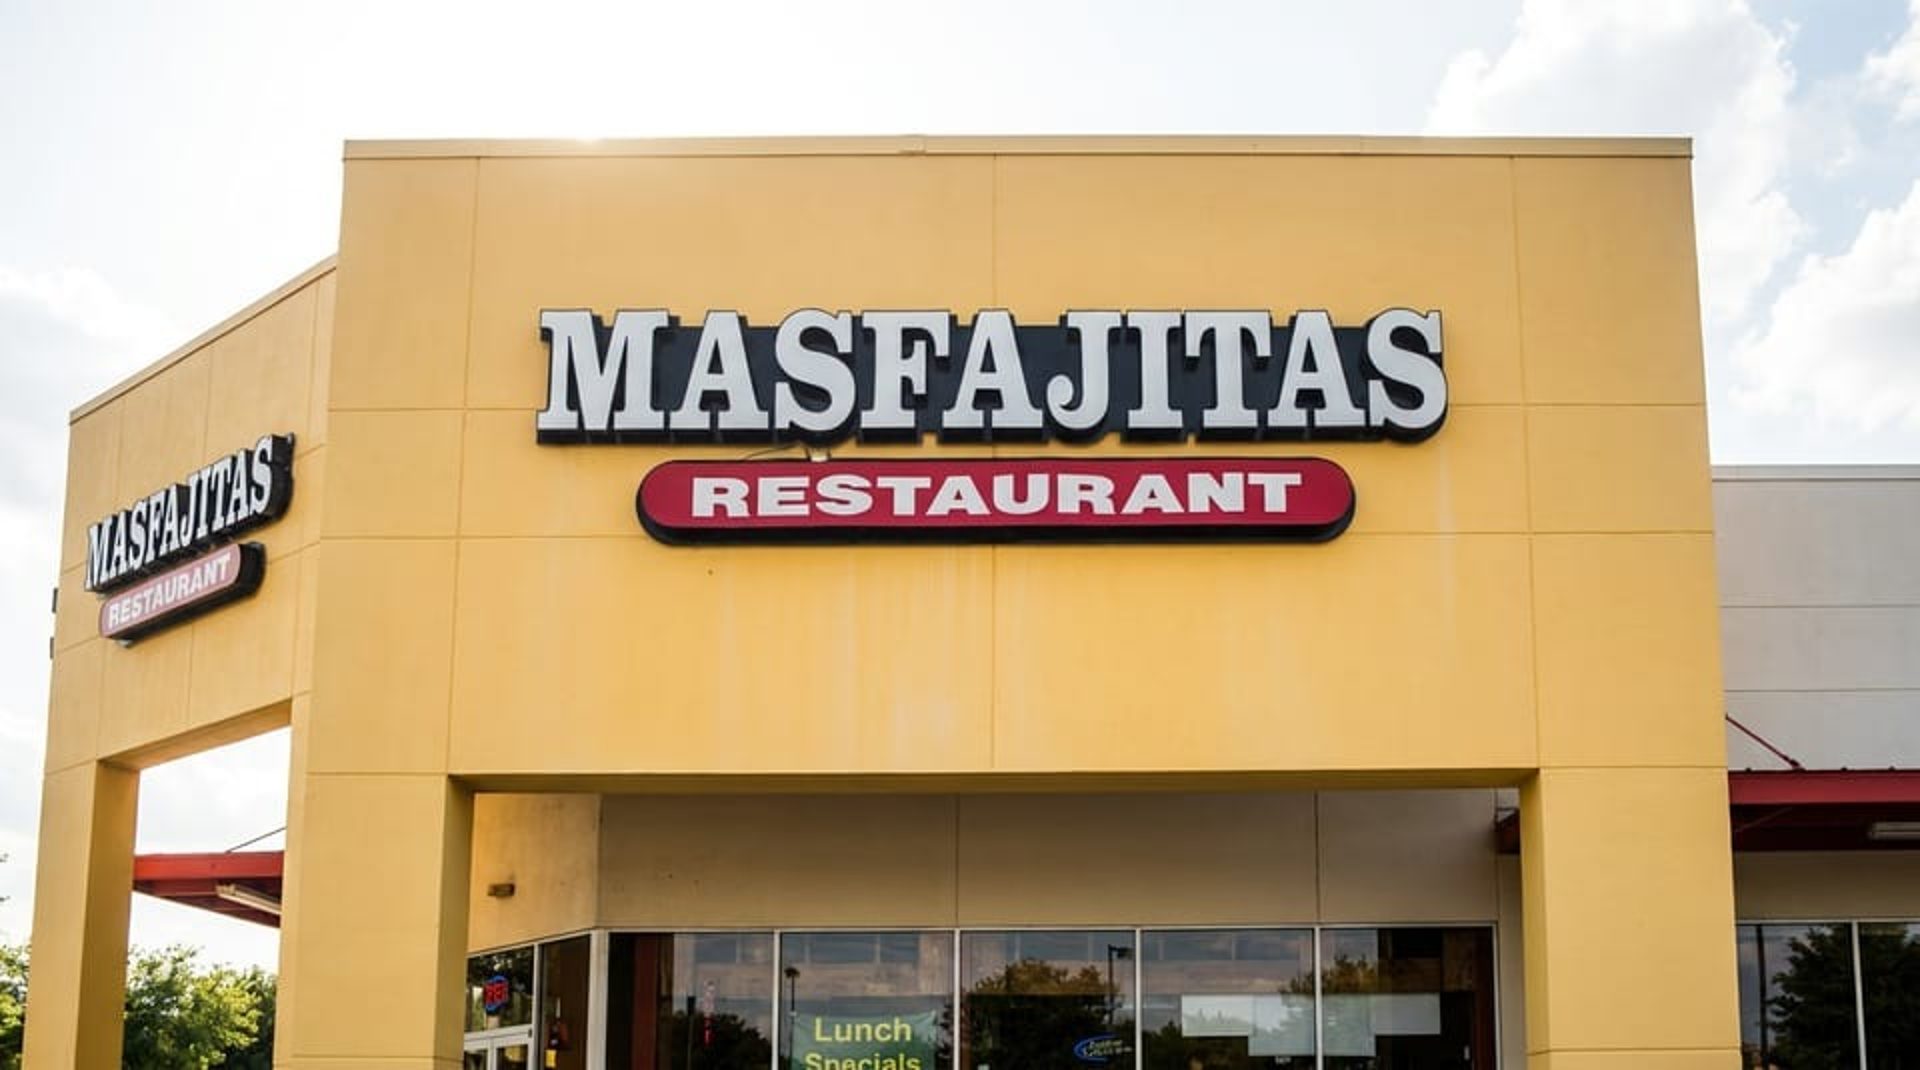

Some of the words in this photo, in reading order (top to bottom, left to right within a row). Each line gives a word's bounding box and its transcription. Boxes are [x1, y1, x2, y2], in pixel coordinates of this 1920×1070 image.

[538, 309, 1447, 431] MASFAJITAS
[84, 436, 273, 590] MASFAJITAS
[691, 473, 1302, 518] RESTAURANT
[107, 552, 232, 629] RESTAURANT
[815, 1016, 912, 1042] Lunch
